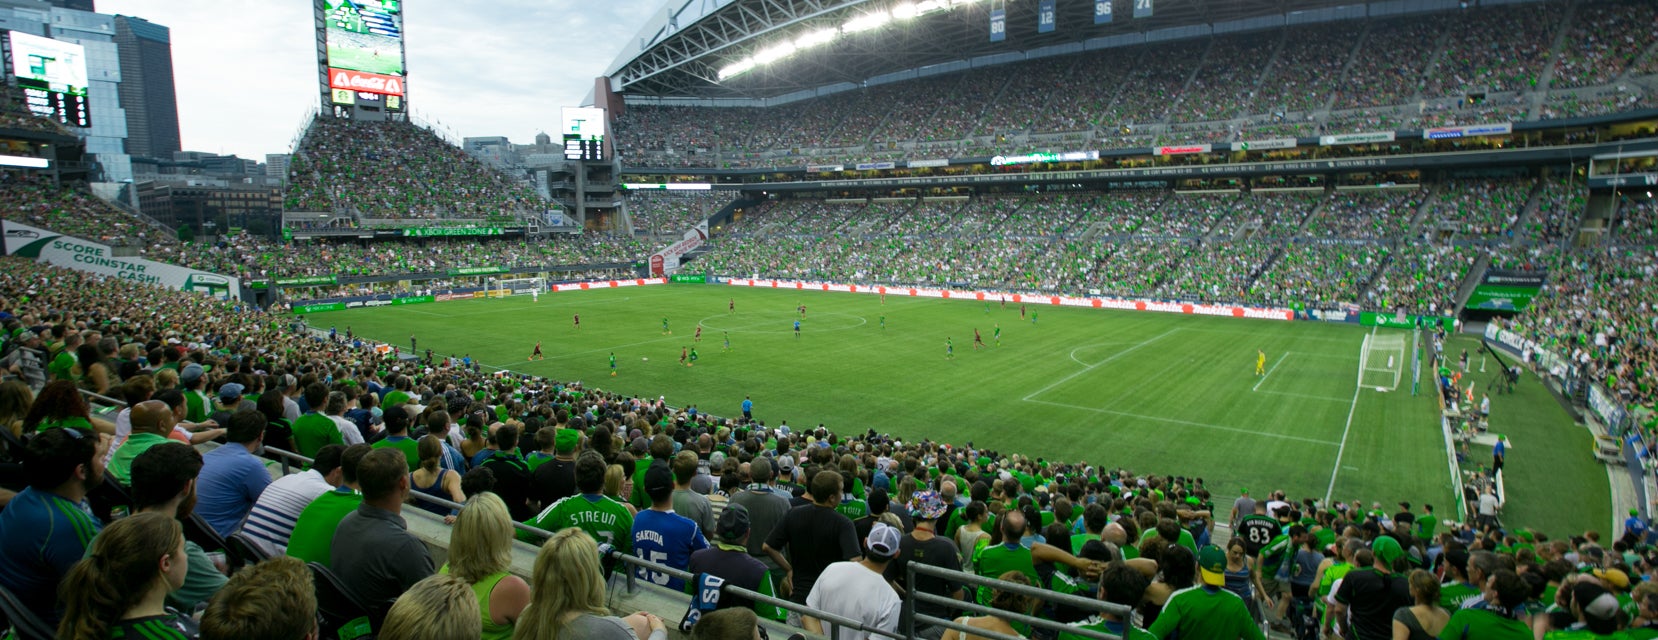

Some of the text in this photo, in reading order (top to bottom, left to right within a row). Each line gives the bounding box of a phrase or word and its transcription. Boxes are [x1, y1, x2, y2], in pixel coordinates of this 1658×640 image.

[1095, 2, 1111, 15] 96
[1041, 11, 1053, 24] 12
[991, 20, 1005, 33] 80
[424, 227, 487, 236] XBOX GREEN ZONE
[53, 240, 105, 257] SCORE
[73, 254, 147, 273] COINSTAR
[117, 270, 161, 285] CASH!
[570, 511, 616, 526] STREUN
[635, 530, 664, 547] SAKUDA
[1249, 526, 1270, 545] 83
[637, 548, 670, 586] 15
